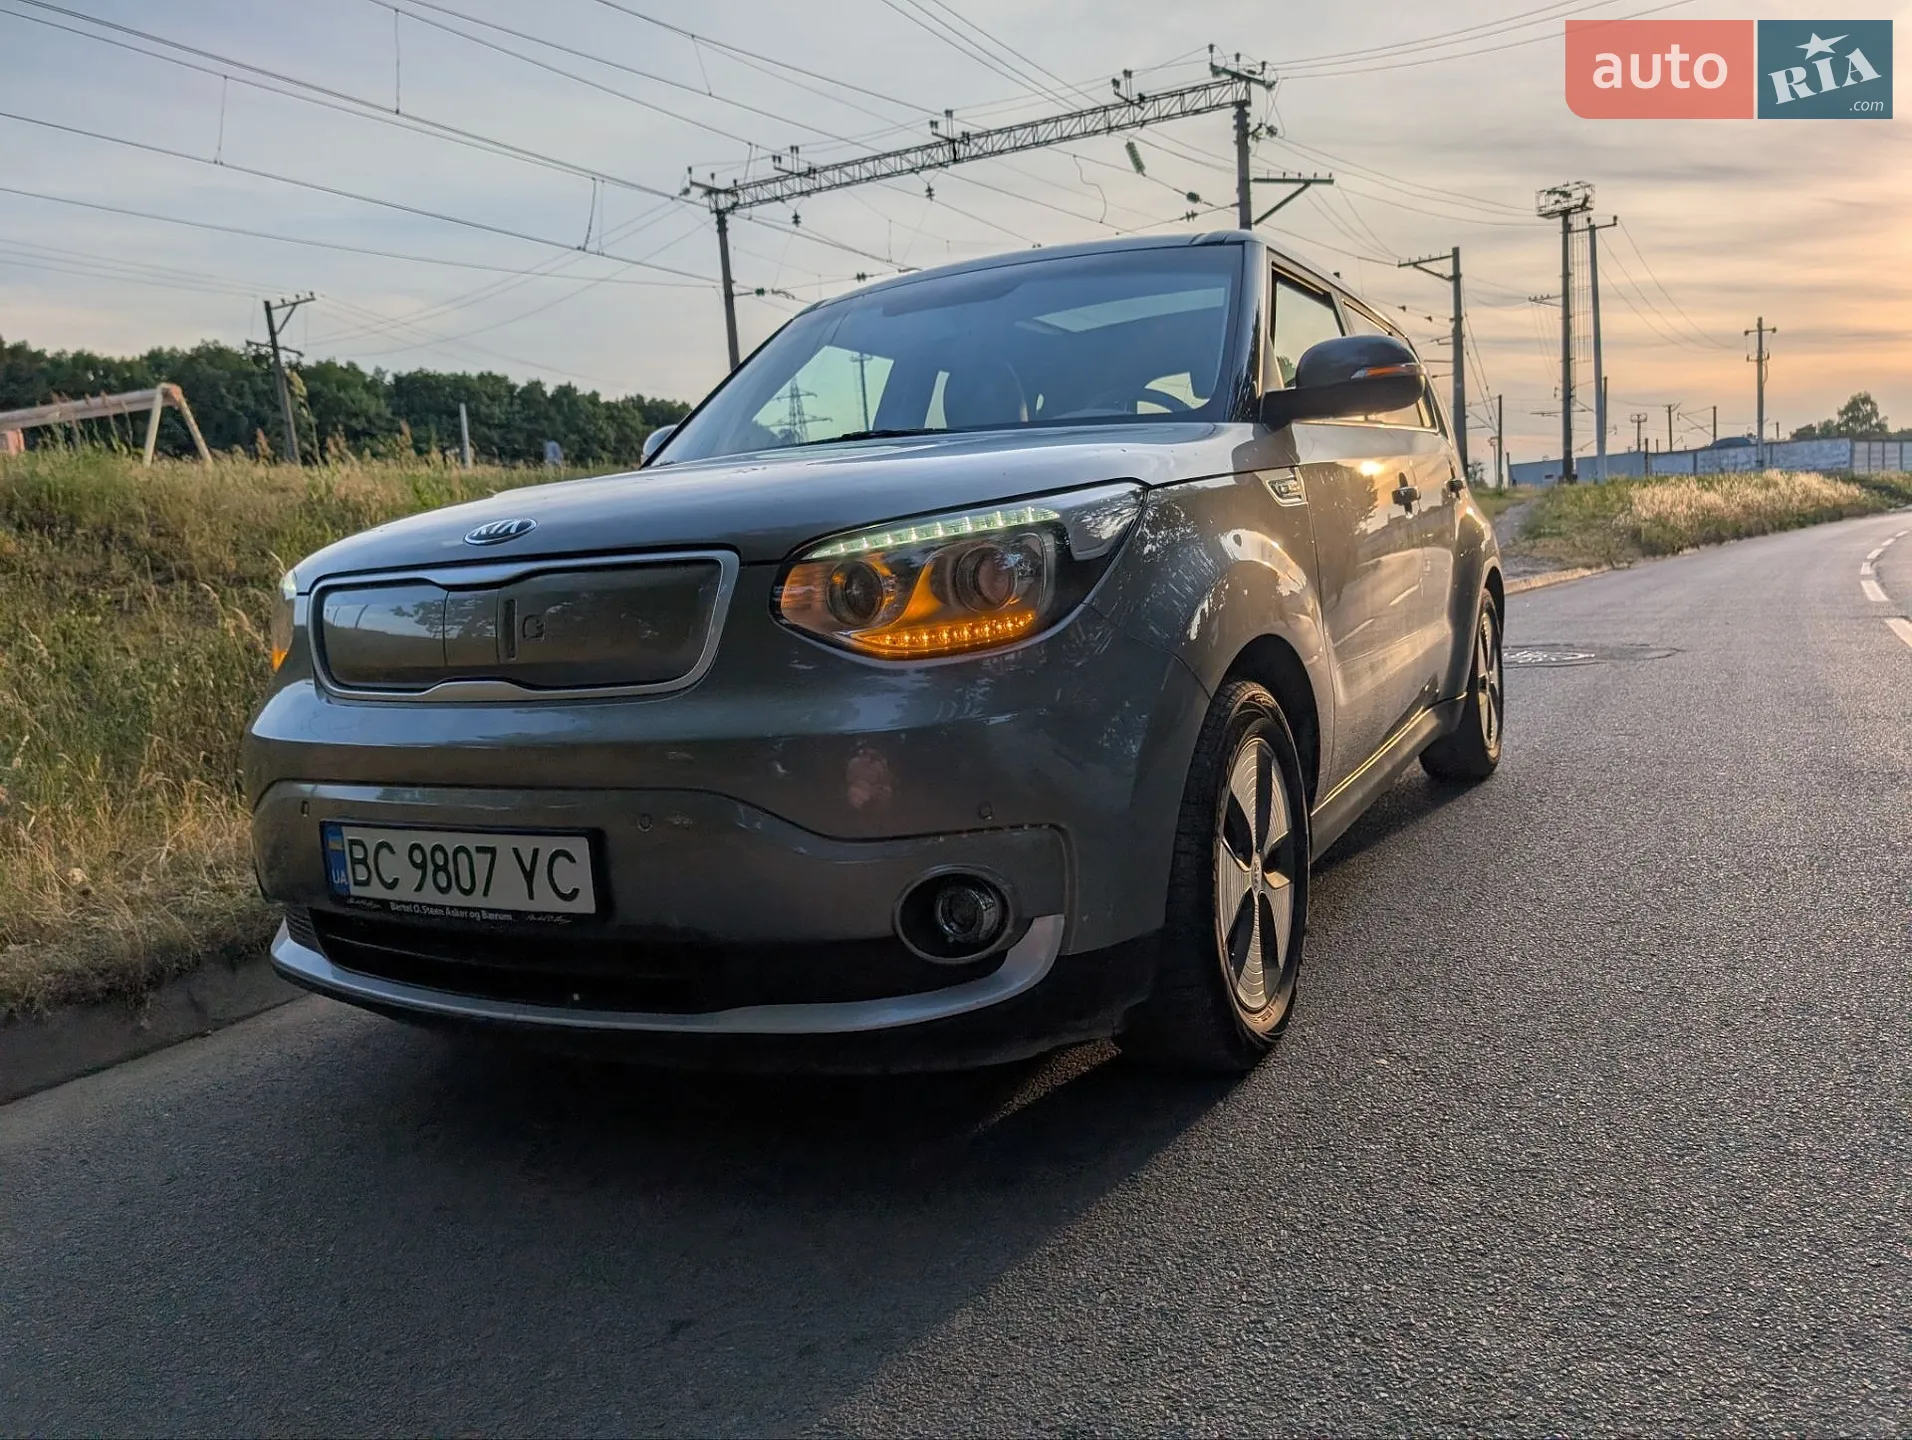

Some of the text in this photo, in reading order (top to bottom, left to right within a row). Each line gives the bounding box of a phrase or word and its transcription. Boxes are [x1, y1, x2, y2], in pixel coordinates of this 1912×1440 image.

[471, 519, 520, 535] KIA
[347, 838, 580, 901] BC 9807 YC
[332, 870, 349, 885] UA
[469, 911, 481, 921] og
